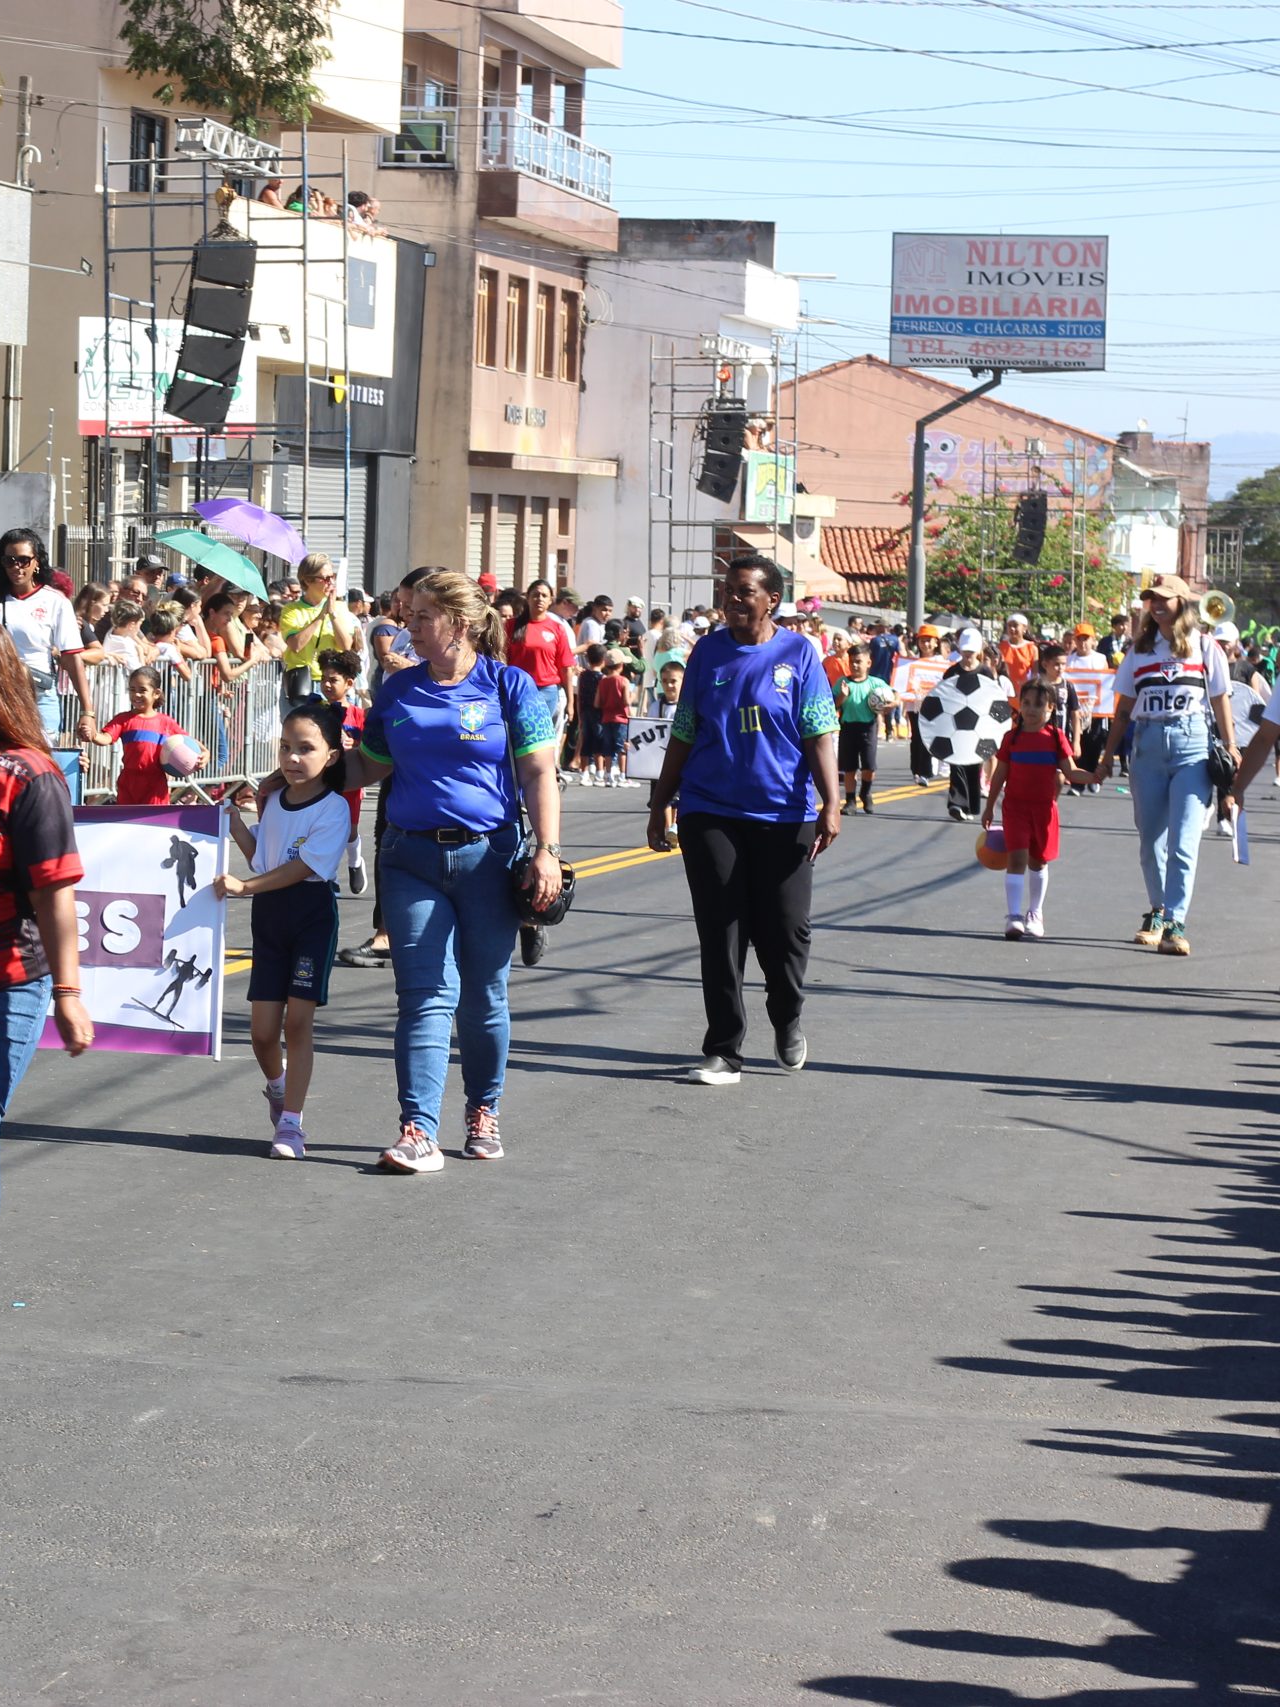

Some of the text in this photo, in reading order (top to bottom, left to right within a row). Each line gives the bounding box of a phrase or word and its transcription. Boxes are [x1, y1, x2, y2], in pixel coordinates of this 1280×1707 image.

[965, 239, 1105, 268] NILTON
[966, 267, 1106, 287] IMÓVEIS
[893, 292, 1104, 318] IMOBILIÁRIA
[893, 320, 964, 334] TERRENOS
[973, 320, 1047, 336] CHÁCARAS
[1057, 322, 1102, 336] SÍTIOS
[901, 338, 1093, 358] TEL. 4692-1162
[908, 355, 1087, 368] www.niltonimoveis.com
[348, 383, 385, 407] ITNESS
[1143, 689, 1195, 713] inter
[738, 704, 762, 733] 10
[459, 733, 488, 742] BRASIL
